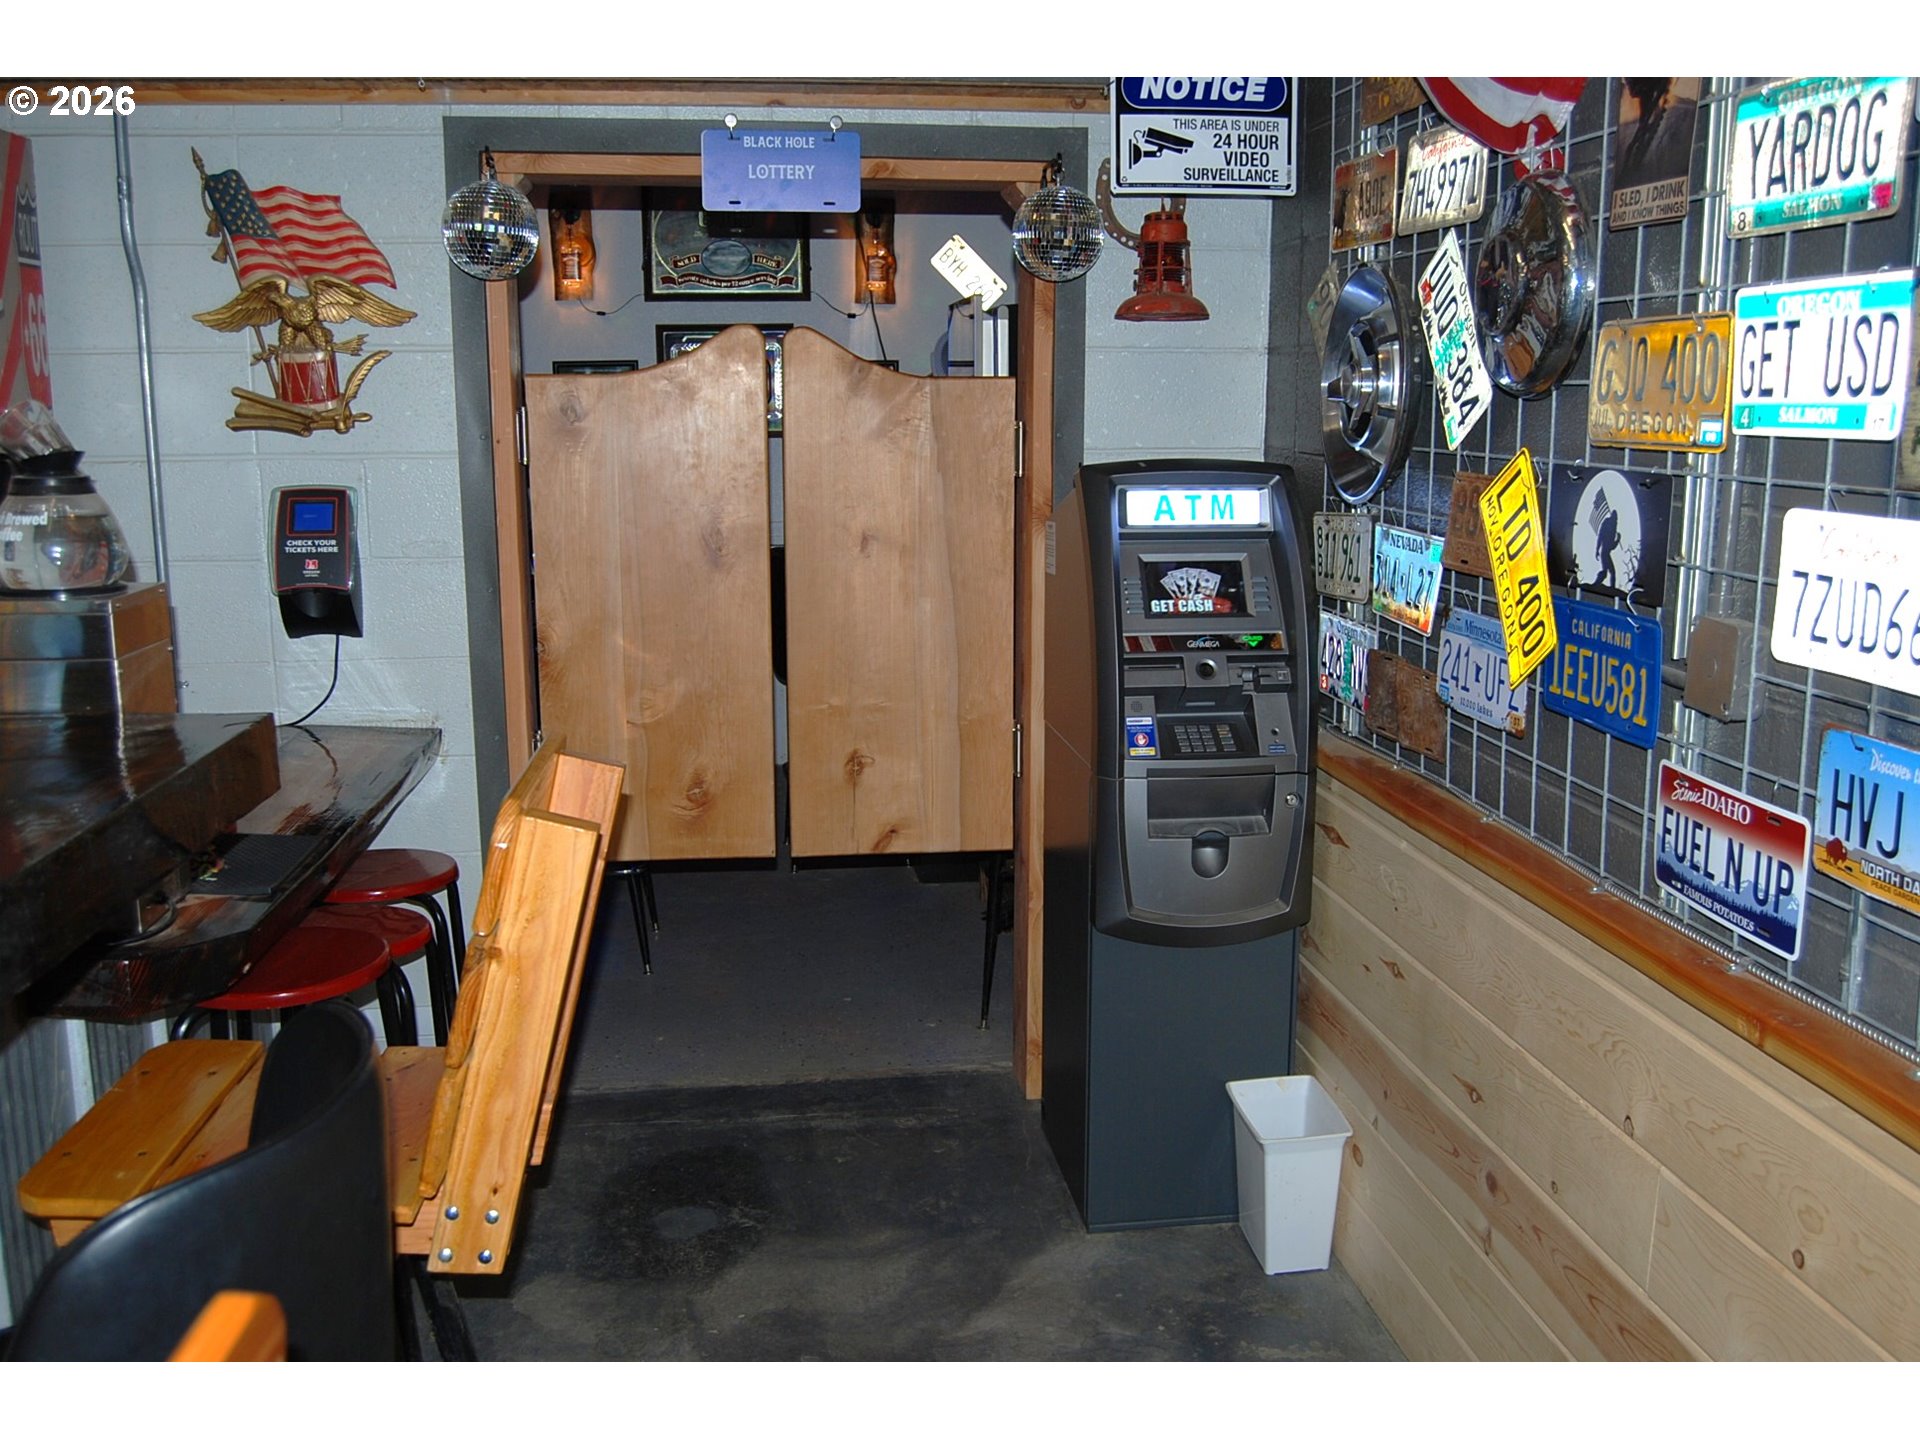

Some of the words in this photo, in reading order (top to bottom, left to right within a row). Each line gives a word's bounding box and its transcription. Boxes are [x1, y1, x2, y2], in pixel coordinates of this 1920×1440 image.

[1139, 77, 1269, 102] NOTICE
[1777, 77, 1863, 112] OREGON
[1173, 119, 1198, 131] THIS
[1199, 119, 1228, 131] AREA
[1230, 120, 1242, 131] IS
[1244, 121, 1280, 133] UNDER
[743, 136, 782, 149] BLACK
[785, 136, 816, 149] HOLE
[1213, 133, 1233, 149] 24
[1237, 134, 1280, 151] HOUR
[1749, 89, 1888, 200] YARDOG
[748, 164, 816, 180] LOTTERY
[1183, 167, 1280, 183] SURVEILLANCE
[1223, 151, 1270, 168] VIDEO
[1408, 153, 1479, 220] 7H49971
[1613, 194, 1618, 210] I
[1619, 189, 1643, 209] SLED,
[1645, 187, 1651, 203] I
[1652, 181, 1685, 203] DRINK
[1612, 211, 1627, 224] AND
[1632, 207, 1655, 220] KNOW
[1656, 201, 1685, 217] THINGS
[1737, 211, 1747, 231] 8
[939, 247, 968, 278] BYH
[1776, 289, 1863, 316] OREGON
[1660, 332, 1721, 405] 400
[1740, 319, 1801, 399] GET
[1822, 312, 1900, 398] USD
[1446, 341, 1480, 428] 384
[1740, 406, 1750, 428] 4
[1778, 406, 1840, 424] SALMON
[1153, 493, 1235, 521] ATM
[1496, 467, 1532, 563] LTD
[284, 546, 317, 554] TICKETS
[286, 539, 312, 547] CHECK
[314, 539, 337, 547] YOUR
[1389, 533, 1424, 555] NEVADA
[1491, 535, 1518, 636] OREGON
[1151, 599, 1174, 613] GET
[1177, 599, 1214, 613] CASH
[1515, 573, 1547, 659] 400
[1791, 569, 1920, 666] 7ZUD66
[1464, 619, 1502, 642] Minnesota
[1571, 618, 1632, 650] CALIFORNIA
[1440, 638, 1471, 693] 241
[1548, 642, 1648, 728] 1EEU581
[1868, 748, 1912, 782] Discover
[1671, 779, 1703, 804] Scenic
[1701, 787, 1751, 826] IDAHO
[1829, 768, 1905, 860] HVJ
[1660, 805, 1716, 882] FUEL
[1723, 836, 1745, 895] N
[1752, 849, 1795, 914] UP
[1859, 858, 1900, 889] NORTH
[1682, 884, 1713, 910] FAMOUS
[1712, 901, 1755, 933] POTATOES
